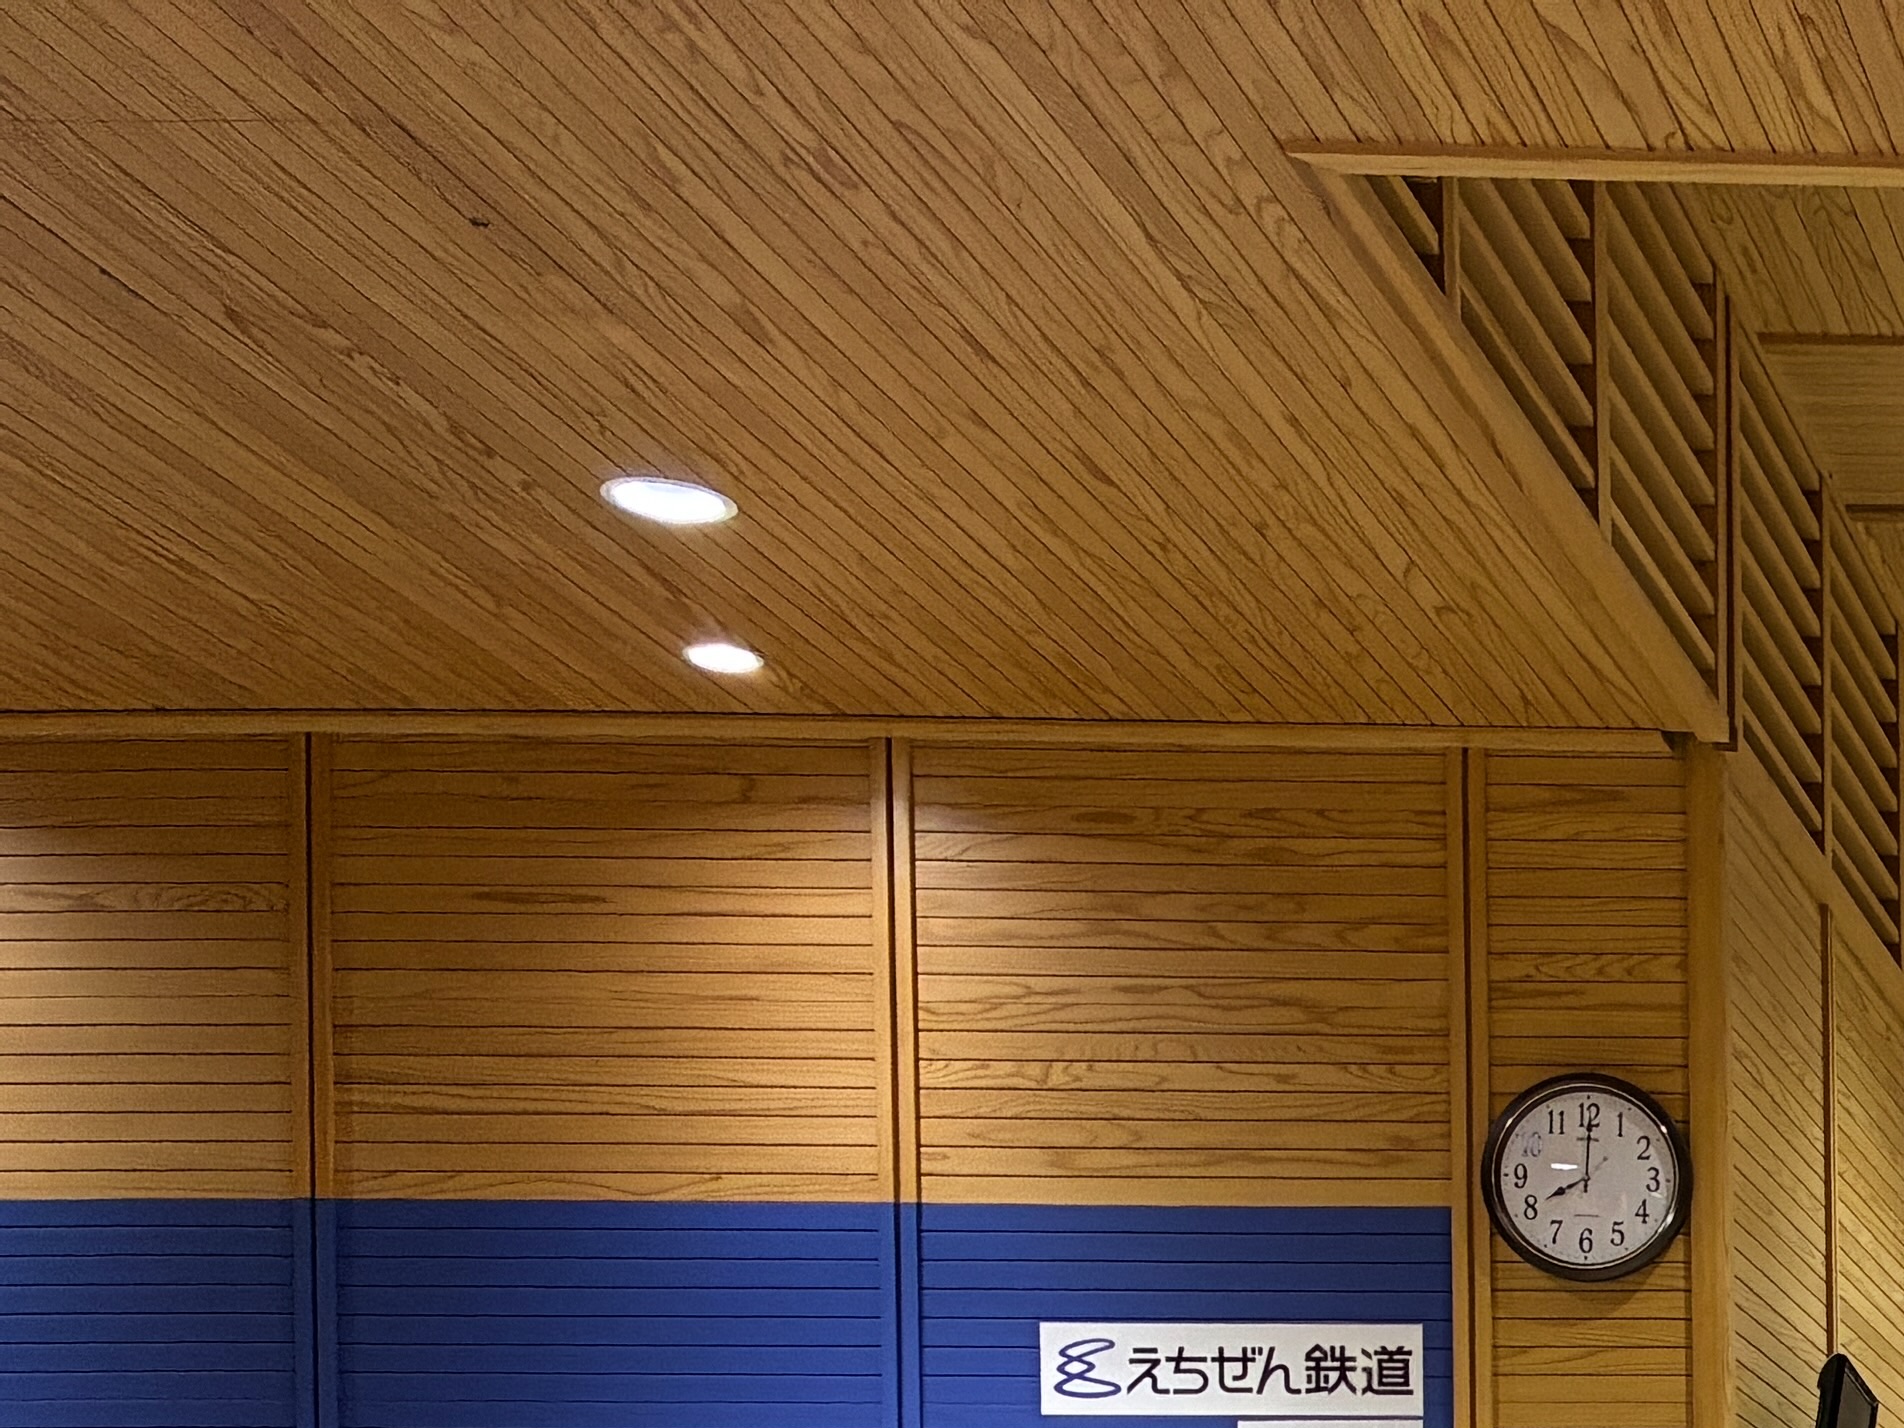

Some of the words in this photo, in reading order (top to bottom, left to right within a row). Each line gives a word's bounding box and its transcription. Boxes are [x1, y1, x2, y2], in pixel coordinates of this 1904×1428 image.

[1548, 1109, 1565, 1135] 11
[1578, 1102, 1600, 1128] 12
[1616, 1112, 1624, 1137] 1
[1636, 1135, 1651, 1160] 2
[1513, 1163, 1528, 1189] 9
[1646, 1167, 1660, 1192] 3
[1523, 1194, 1538, 1220] 8
[1634, 1198, 1649, 1224] 4
[1550, 1220, 1563, 1244] 7
[1578, 1228, 1593, 1253] 6
[1610, 1221, 1625, 1246] 5
[1126, 1343, 1415, 1397] えちぜん鉄道
